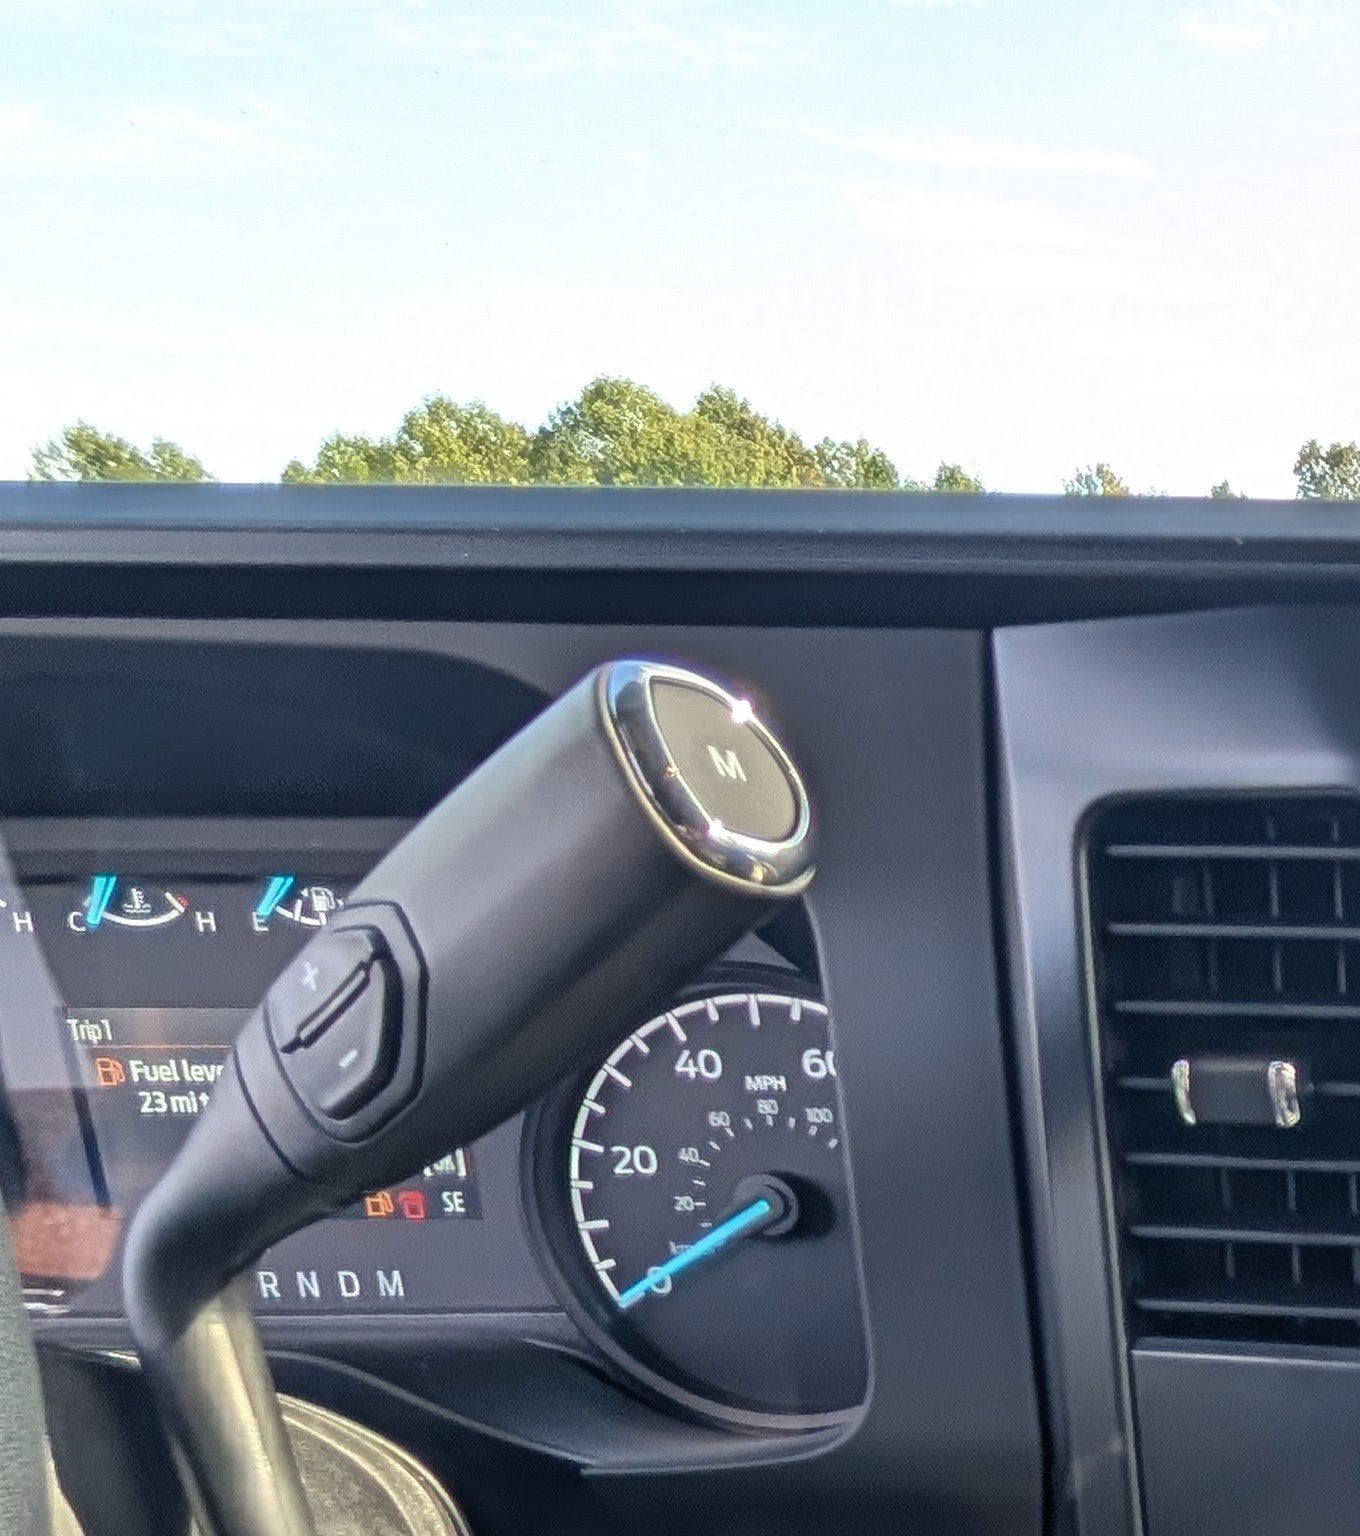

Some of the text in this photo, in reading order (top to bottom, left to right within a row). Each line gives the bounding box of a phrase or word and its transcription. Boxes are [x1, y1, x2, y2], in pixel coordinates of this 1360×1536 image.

[706, 744, 748, 783] M
[13, 911, 34, 932] H
[195, 911, 217, 932] H
[129, 1059, 180, 1082] Fuel
[674, 1049, 723, 1080] 40
[744, 1075, 787, 1092] MPH
[138, 1091, 168, 1113] 23
[756, 1098, 780, 1115] 80
[708, 1110, 731, 1128] 60
[803, 1107, 834, 1124] 100
[610, 1145, 659, 1175] 20
[441, 1190, 466, 1213] SE
[257, 1270, 404, 1298] R N D M
